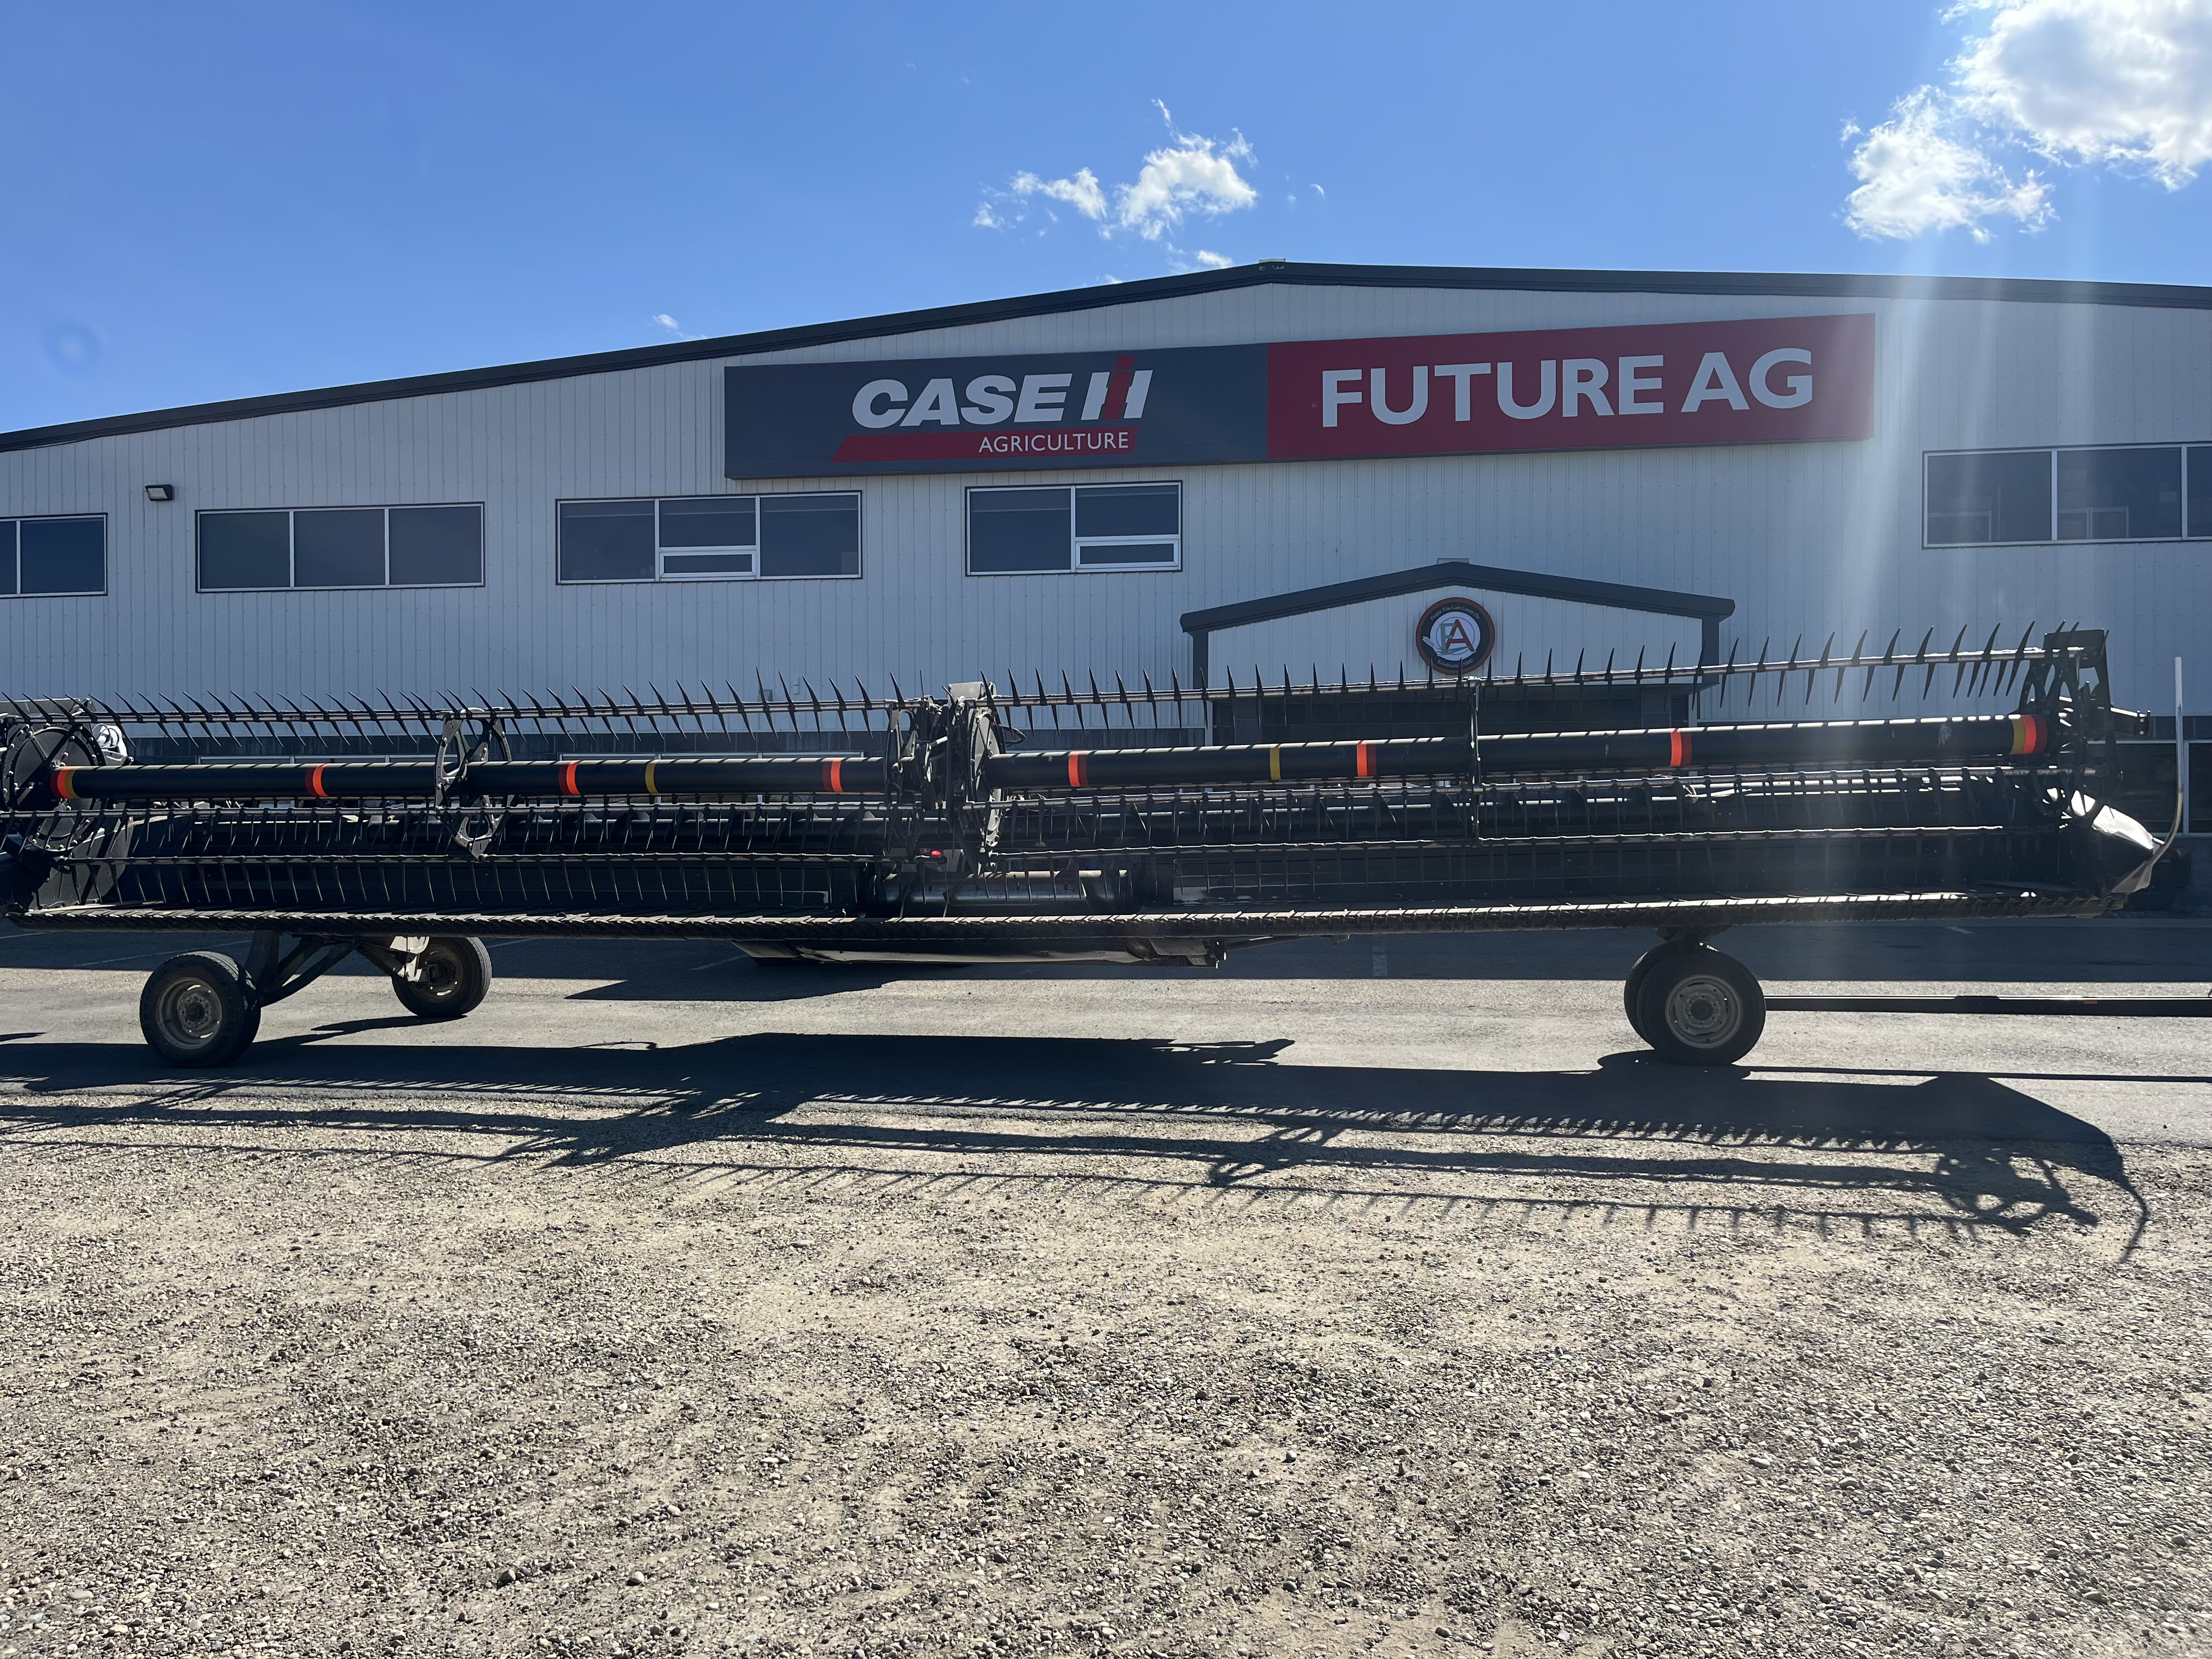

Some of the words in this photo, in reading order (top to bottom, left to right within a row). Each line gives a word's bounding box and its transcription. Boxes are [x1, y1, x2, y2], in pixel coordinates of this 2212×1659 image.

[1321, 355, 1664, 428] FUTURE
[1680, 347, 1814, 413] AG
[852, 373, 1073, 428] CASE
[978, 431, 1129, 453] AGRICULTURE
[1430, 609, 1442, 621] People
[1461, 606, 1475, 614] Count
[1437, 659, 1460, 668] Establishe
[1462, 658, 1474, 667] 2000
